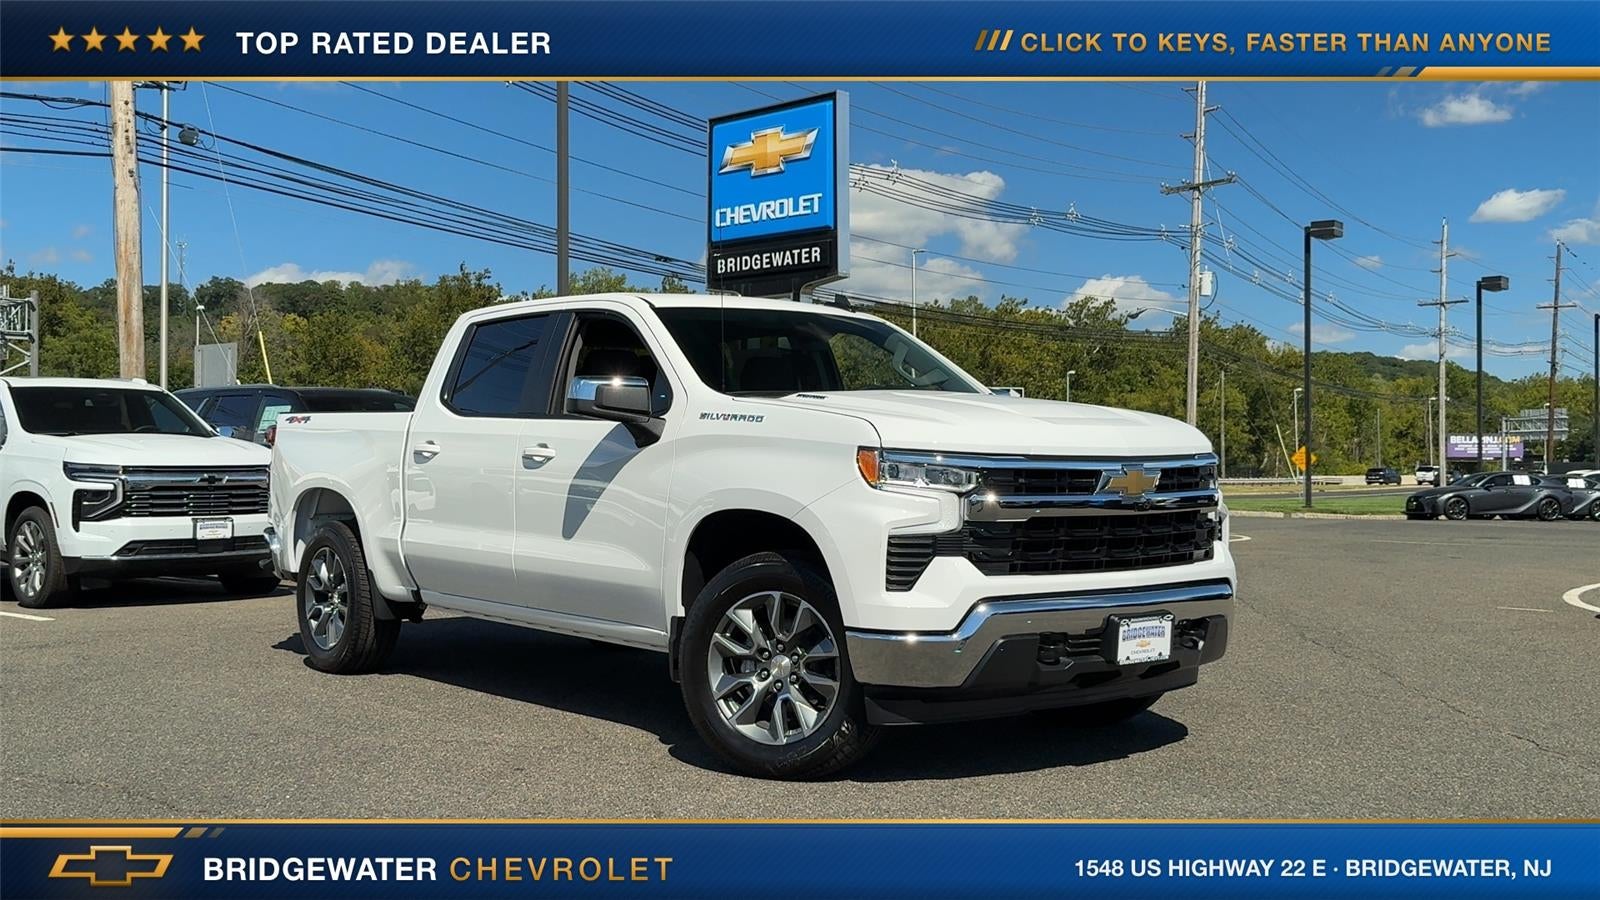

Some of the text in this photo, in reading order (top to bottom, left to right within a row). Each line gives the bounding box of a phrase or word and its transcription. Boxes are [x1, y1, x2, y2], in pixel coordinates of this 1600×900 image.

[715, 193, 823, 228] CHEVROLET
[717, 246, 821, 274] BRIDGEWATER
[699, 411, 765, 423] SILVERADO
[1122, 626, 1165, 641] BRIDGEWATER
